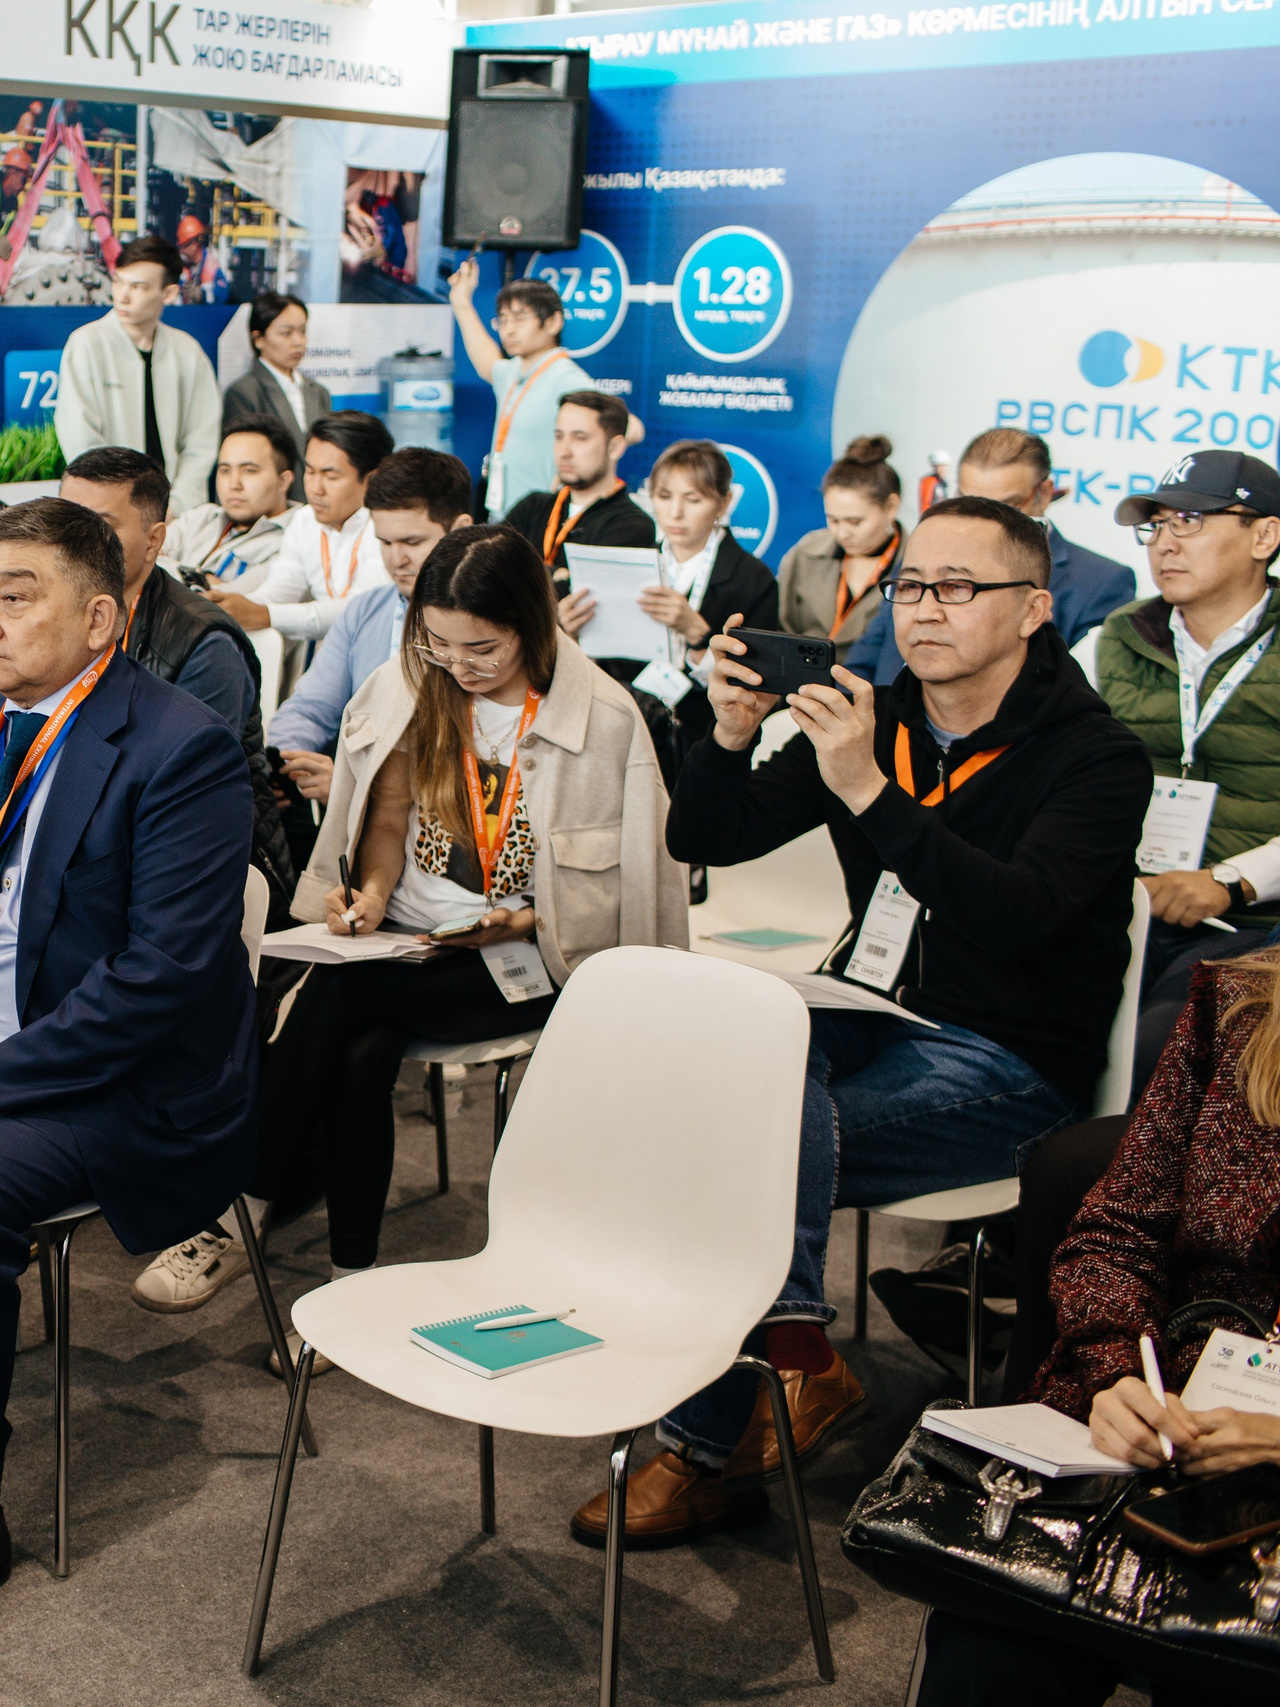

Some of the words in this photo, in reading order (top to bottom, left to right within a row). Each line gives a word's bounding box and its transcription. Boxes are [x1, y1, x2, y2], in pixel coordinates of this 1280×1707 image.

[192, 8, 229, 33] ТАР
[235, 15, 331, 45] ЖЕРЛЕРІН
[753, 17, 833, 46] ЖӘНЕ
[192, 44, 245, 70] ЖОЮ
[251, 49, 403, 88] БАҒДАРЛАМАСЫ
[645, 167, 786, 192] Қазақстанда:
[693, 266, 772, 305] 1.28
[19, 370, 59, 409] 72
[995, 399, 1159, 442] РВСПК
[40, 698, 75, 744] INTERNATIONAL
[1211, 1383, 1253, 1400] Сосновских
